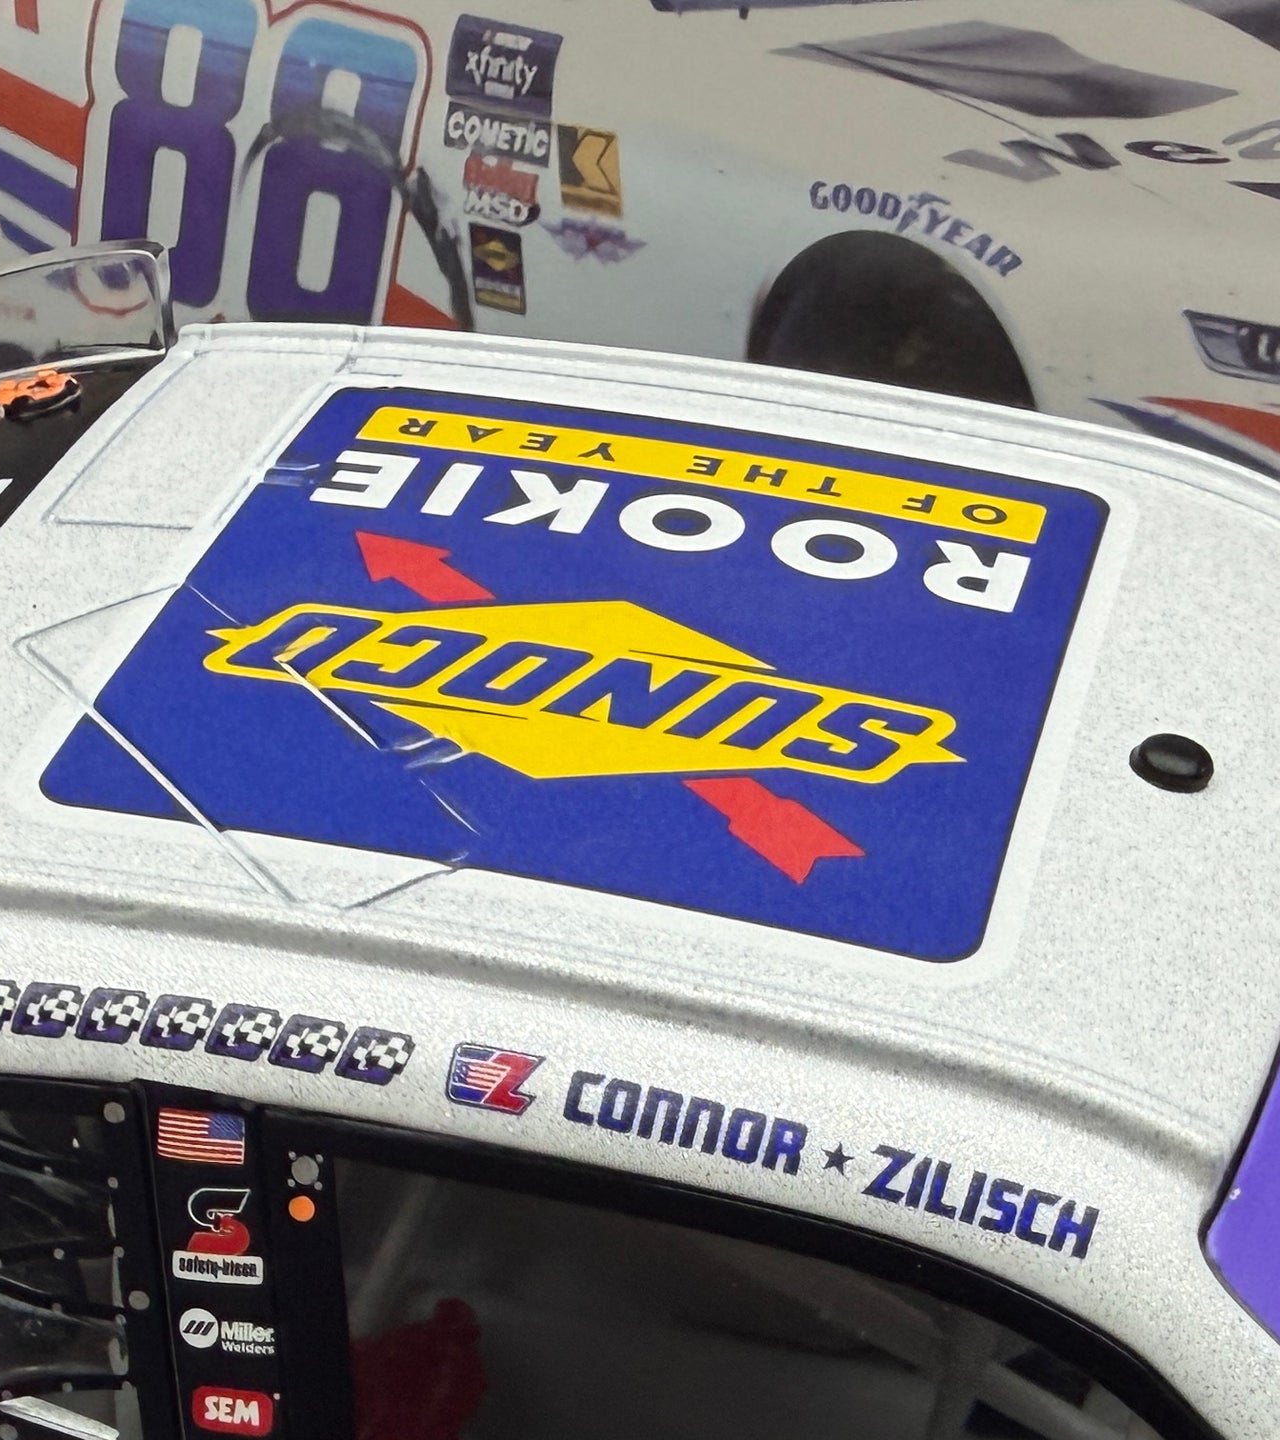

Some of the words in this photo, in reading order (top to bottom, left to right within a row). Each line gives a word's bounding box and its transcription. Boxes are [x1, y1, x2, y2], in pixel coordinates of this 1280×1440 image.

[100, 0, 418, 322] 88
[809, 180, 1024, 278] GOODYEAR
[397, 417, 616, 463] YEAR
[685, 454, 843, 498] THE
[309, 450, 1031, 614] ROOKIE
[901, 494, 1008, 525] OF
[225, 611, 934, 772] SUNOCO
[562, 1070, 810, 1176] CONNOR
[862, 1143, 1100, 1260] ZILISCH
[221, 1320, 275, 1344] Miller
[204, 1395, 261, 1427] SEM
